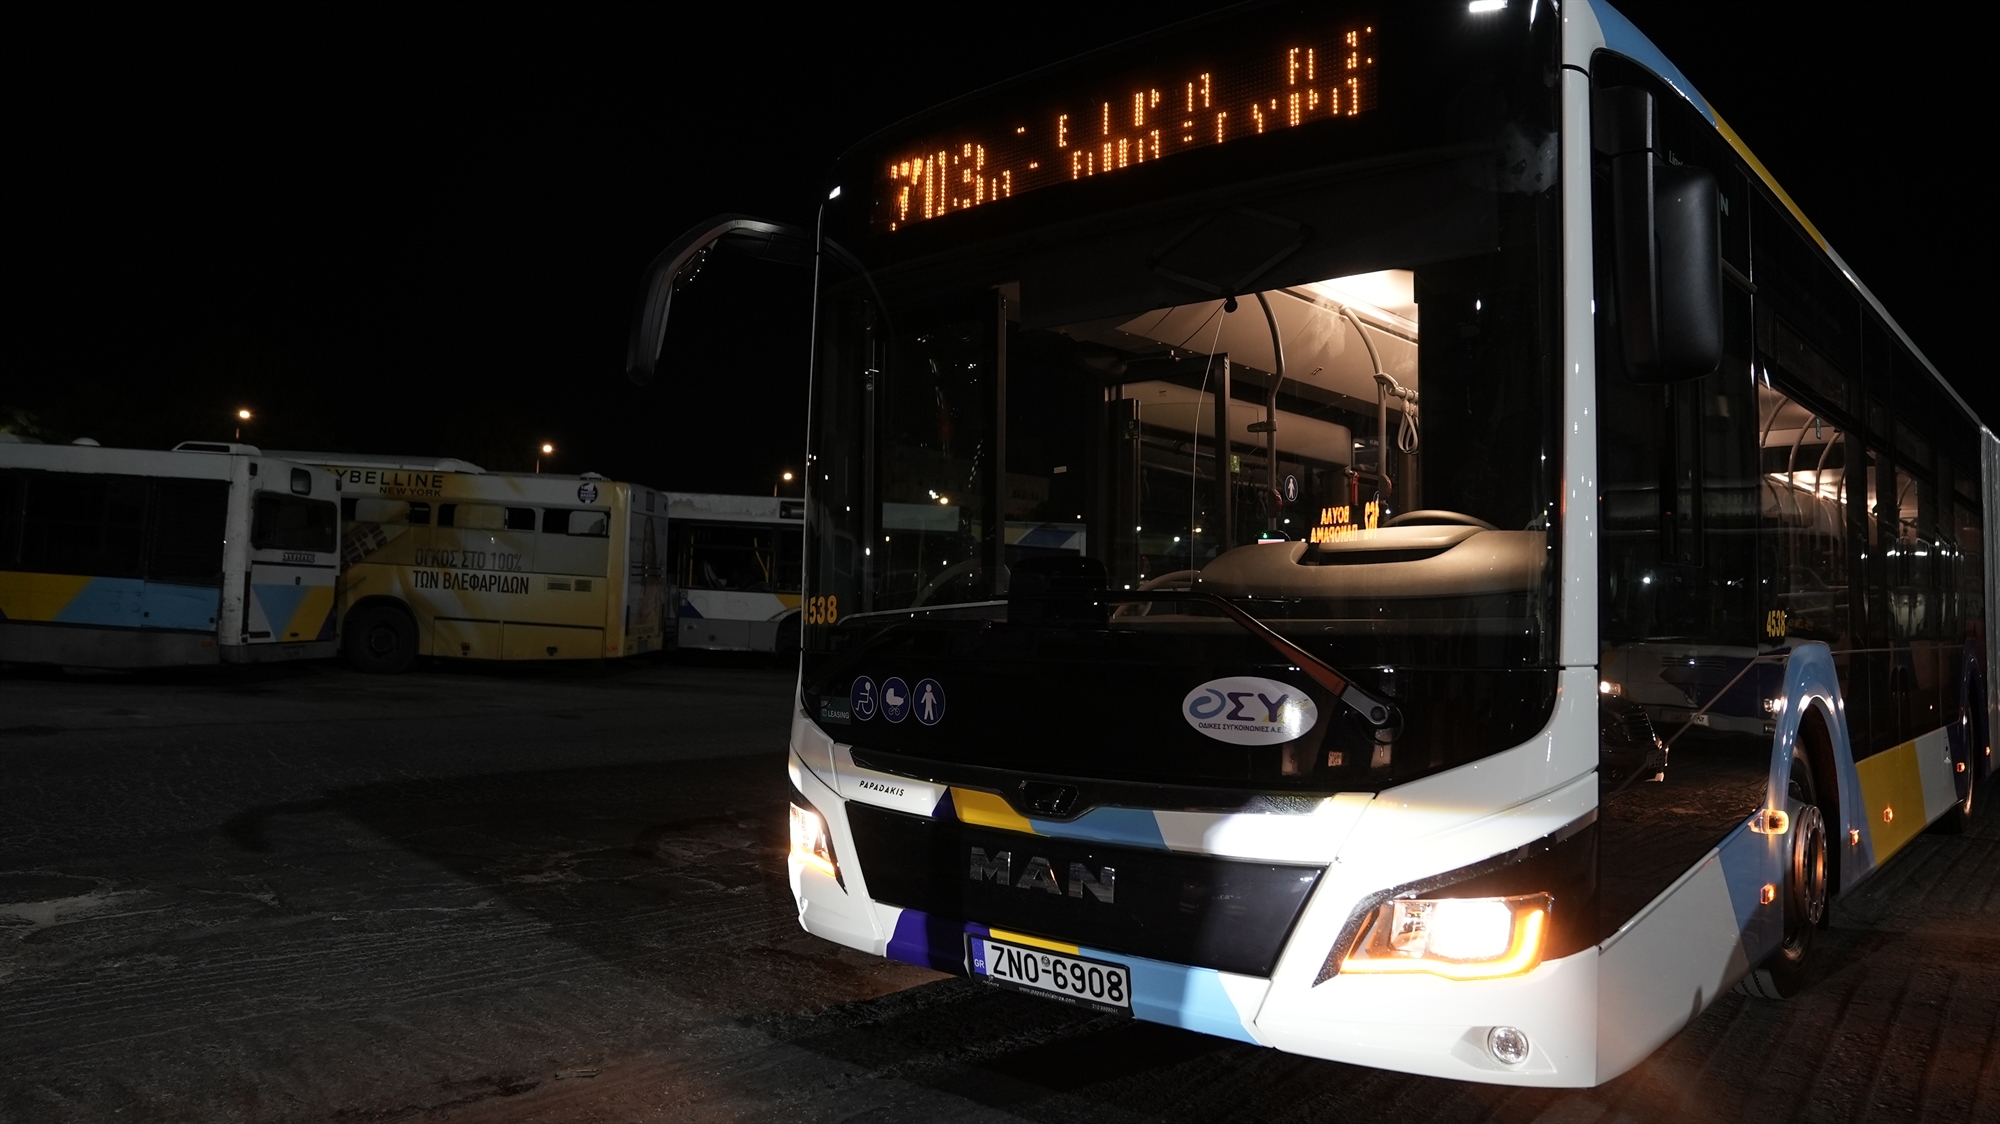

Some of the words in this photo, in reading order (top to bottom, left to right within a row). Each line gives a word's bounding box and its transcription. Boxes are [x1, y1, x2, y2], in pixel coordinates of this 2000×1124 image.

[890, 142, 985, 231] 703
[333, 468, 444, 489] YBELLINE
[379, 486, 407, 496] NEW
[410, 488, 442, 498] YORK
[415, 548, 459, 568] ΟΓΚΟΣ
[461, 549, 486, 570] ΣΤΟ
[490, 552, 522, 572] 100%
[413, 570, 439, 589] ΤΩΝ
[443, 572, 529, 595] ΒΛΕΦΑΡΙΔΩΝ
[1766, 609, 1786, 638] 4538
[827, 709, 850, 720] LEASING
[1198, 722, 1221, 730] ΟΔΙΚΕΣ
[1222, 723, 1269, 733] ΣΥΓΚΟΙΝΩΝΙΕΣ
[858, 780, 905, 797] PAPADAKIS
[969, 846, 1117, 904] MAN
[973, 958, 985, 969] GR
